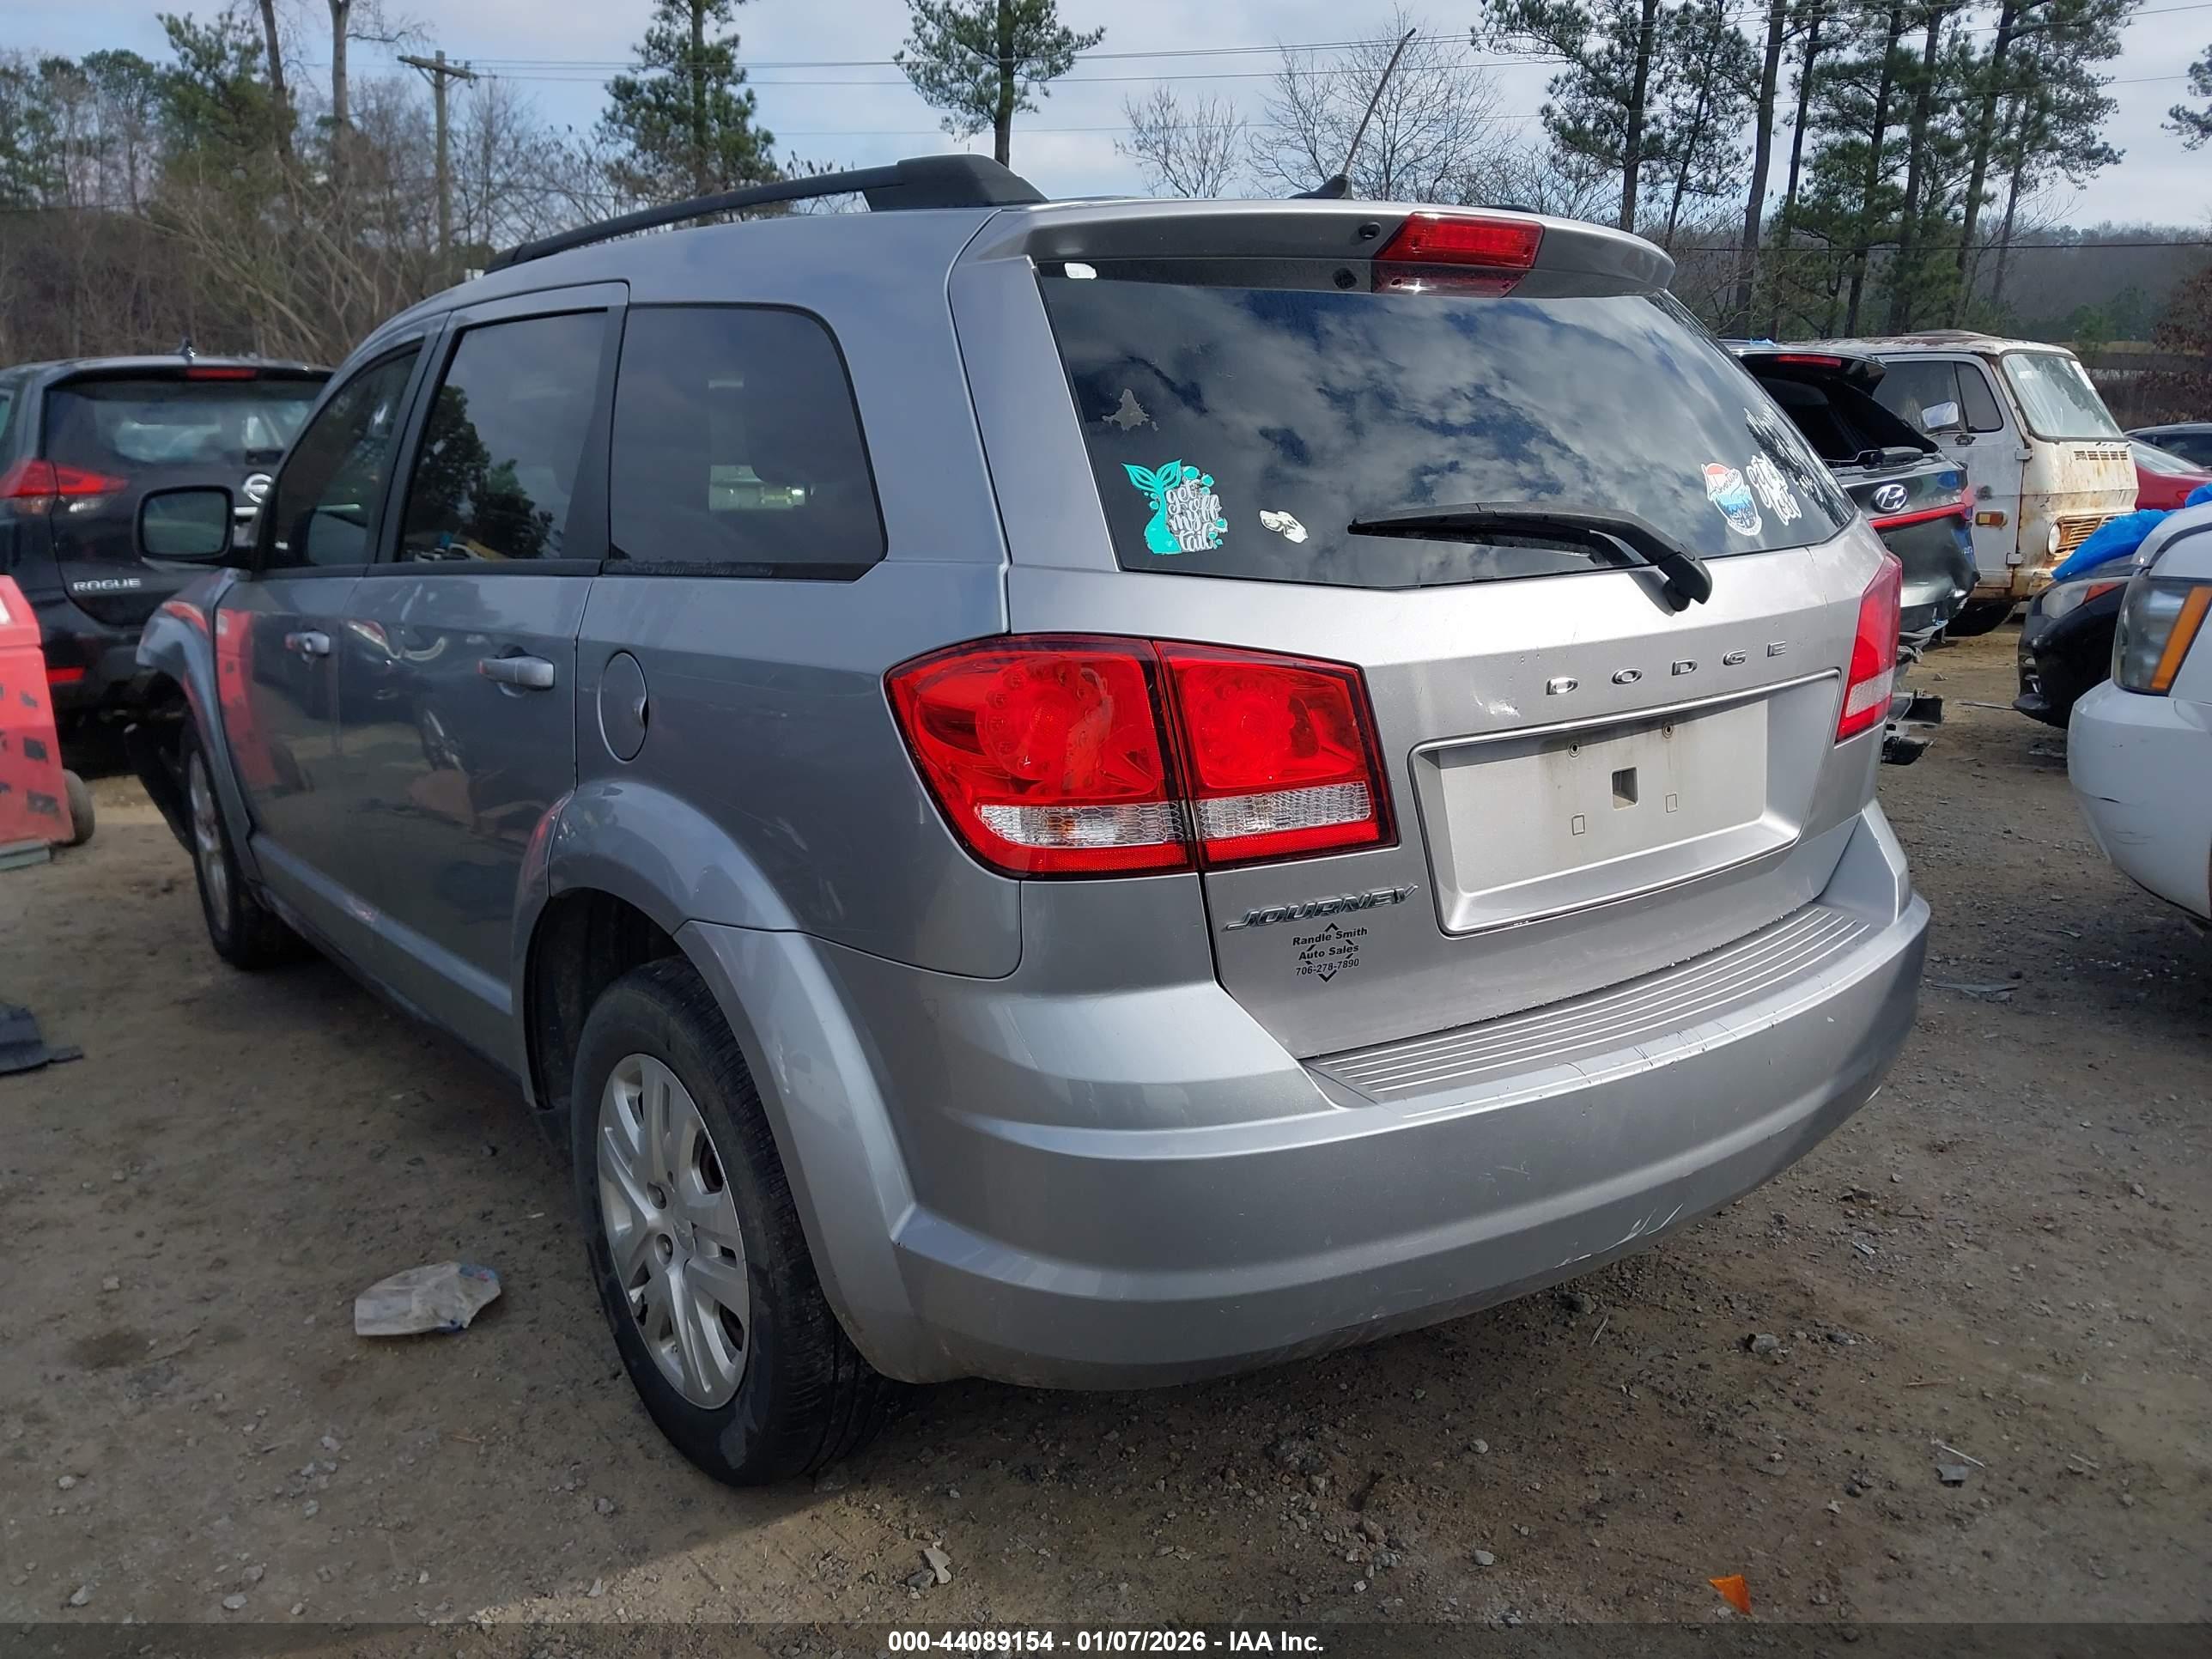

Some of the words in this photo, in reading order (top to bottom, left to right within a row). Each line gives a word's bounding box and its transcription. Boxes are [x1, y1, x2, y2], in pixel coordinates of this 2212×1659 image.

[1166, 479, 1202, 515] get
[1187, 495, 1222, 521] off
[1169, 507, 1201, 532] my
[1175, 522, 1214, 550] tail
[73, 578, 141, 592] ROGUE
[1546, 641, 1786, 696] DODGE
[1224, 884, 1418, 931] JOURNEY
[1292, 932, 1332, 946] Randle
[1335, 927, 1368, 939] Smith
[1298, 949, 1325, 961] Auto
[1328, 945, 1358, 956] Sales
[1295, 957, 1359, 976] 706-278-7890
